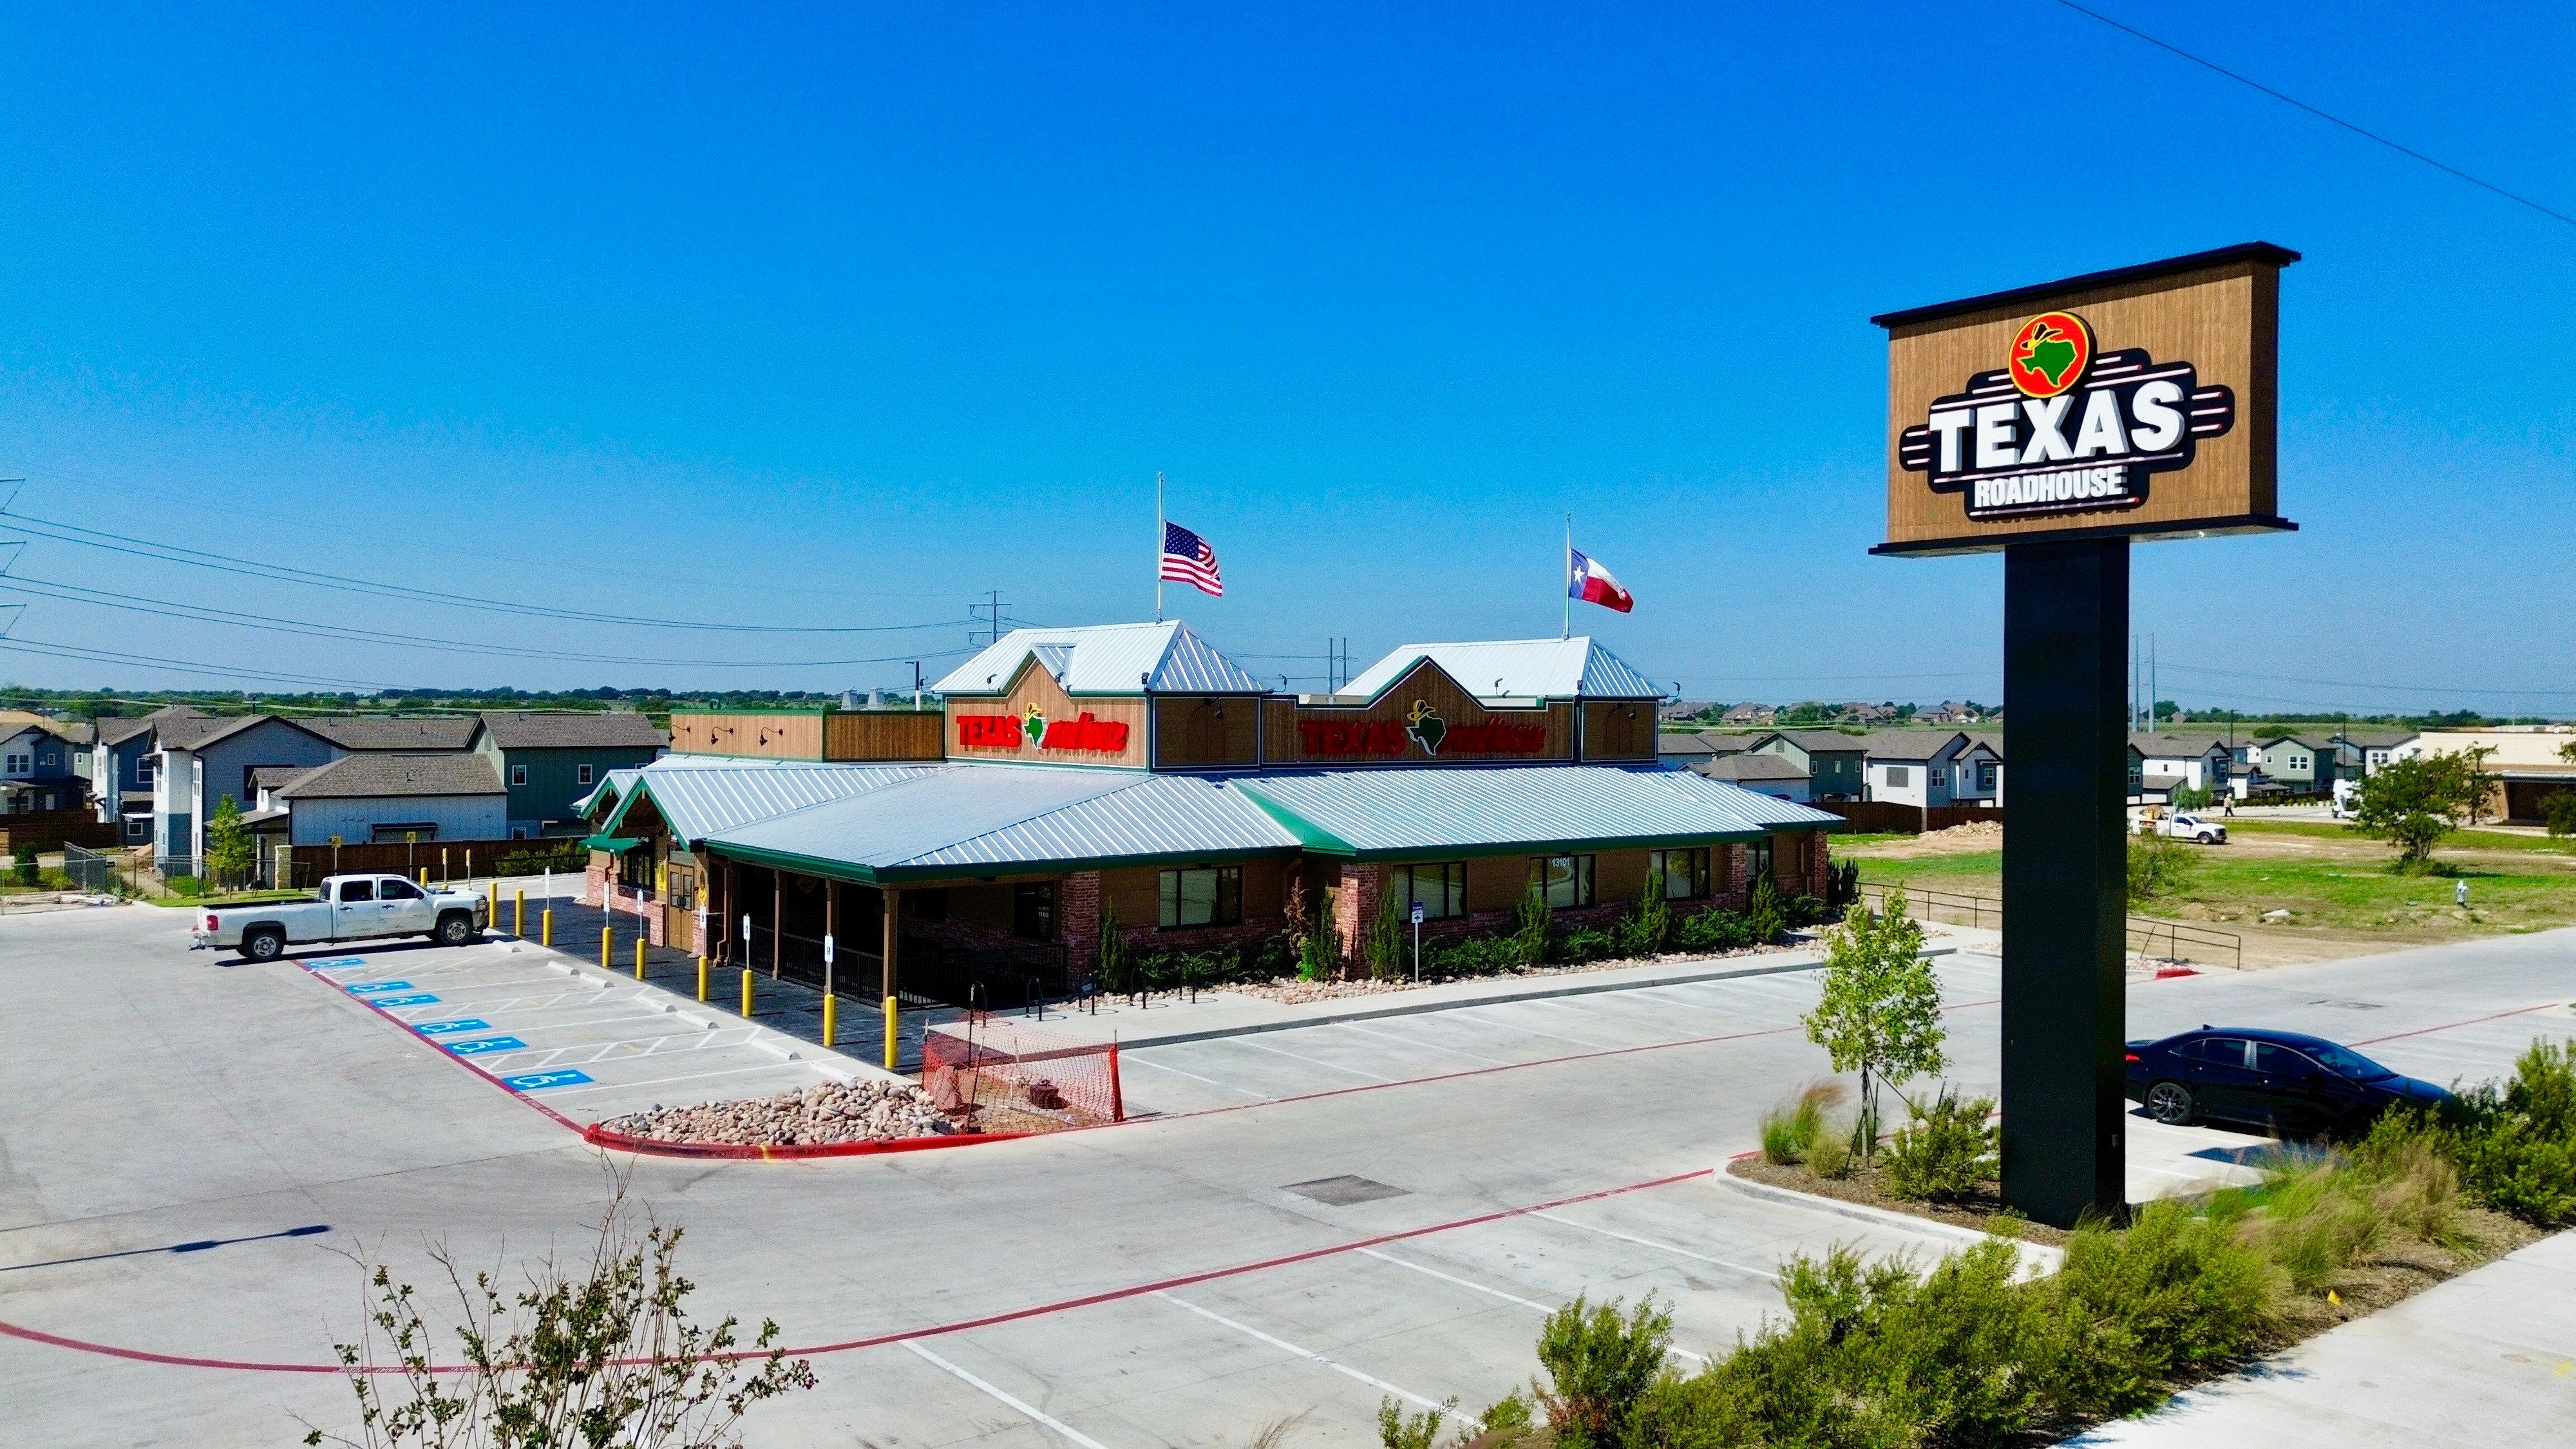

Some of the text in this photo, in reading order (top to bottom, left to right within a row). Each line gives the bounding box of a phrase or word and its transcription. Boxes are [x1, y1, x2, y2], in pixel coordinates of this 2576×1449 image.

[1929, 380, 2185, 473] TEXAS
[1975, 465, 2128, 507] ROADHOUSE
[956, 715, 1022, 748] TEXAS
[1300, 720, 1405, 754] TEXAS
[1552, 857, 1570, 867] 13101
